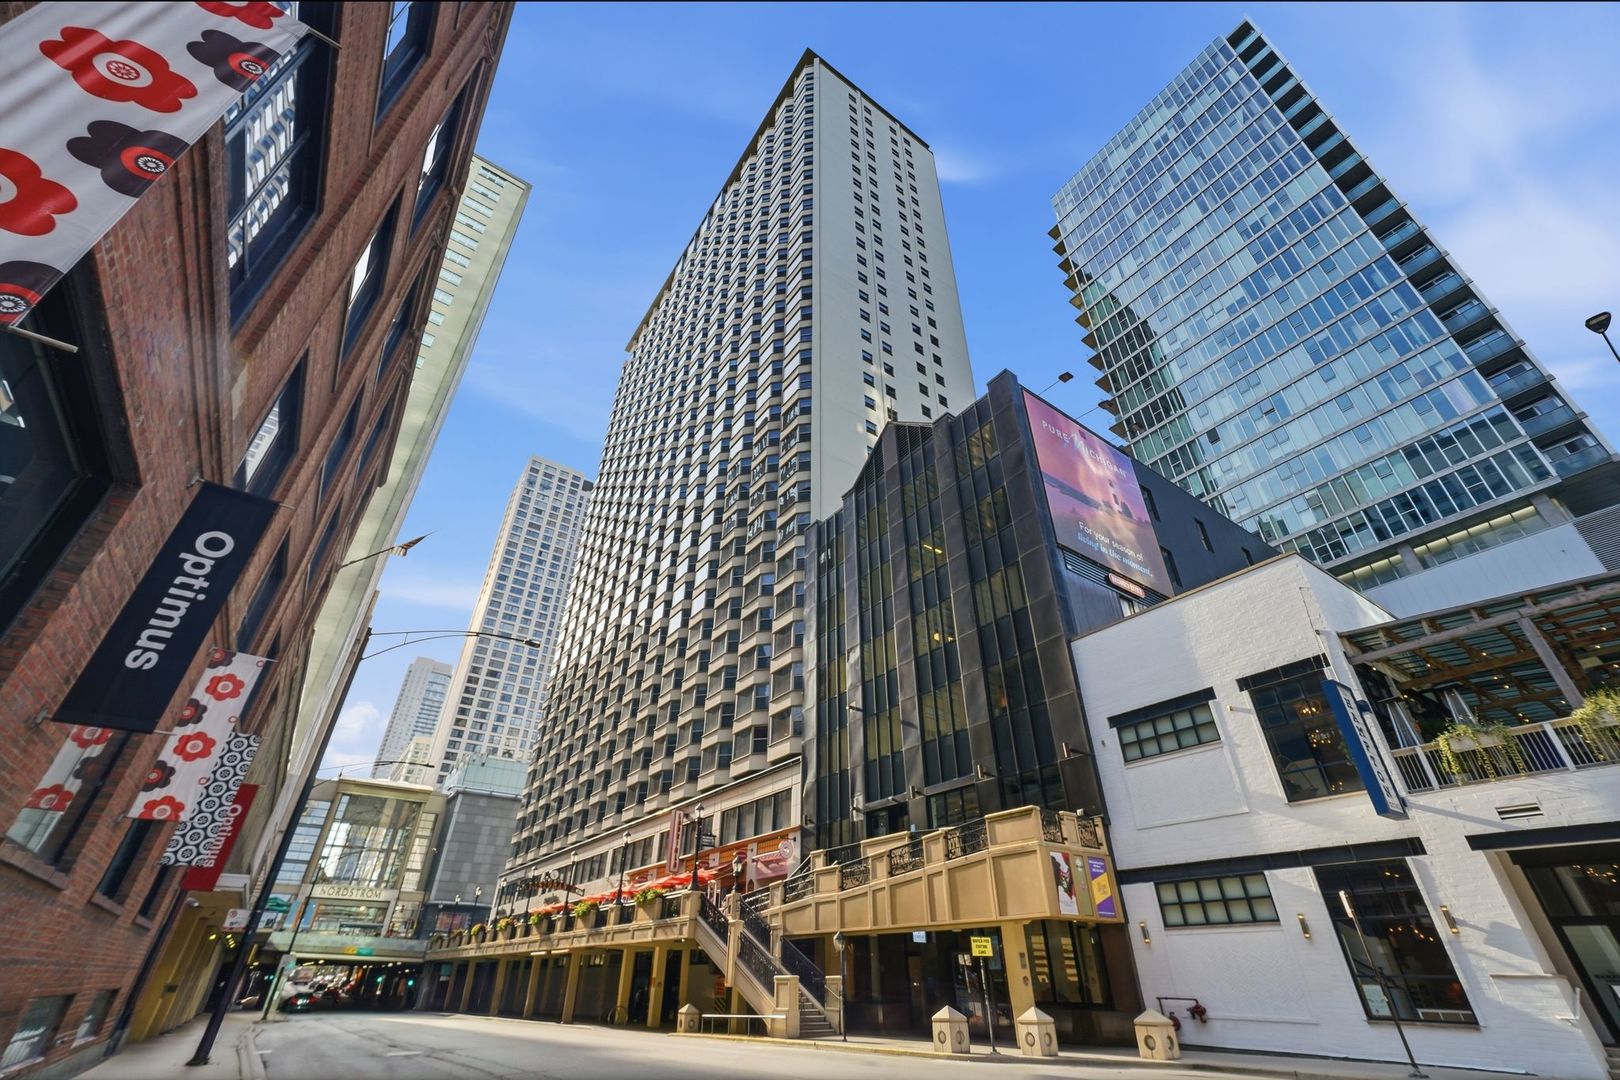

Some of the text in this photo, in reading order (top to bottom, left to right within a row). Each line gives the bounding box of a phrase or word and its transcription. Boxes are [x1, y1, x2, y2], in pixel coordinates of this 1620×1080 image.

[1041, 419, 1070, 444] PURE
[1078, 521, 1092, 535] For
[1093, 531, 1110, 545] your
[124, 530, 235, 670] Optimus
[202, 803, 242, 868] Optimus
[320, 885, 382, 898] NORDSTROM
